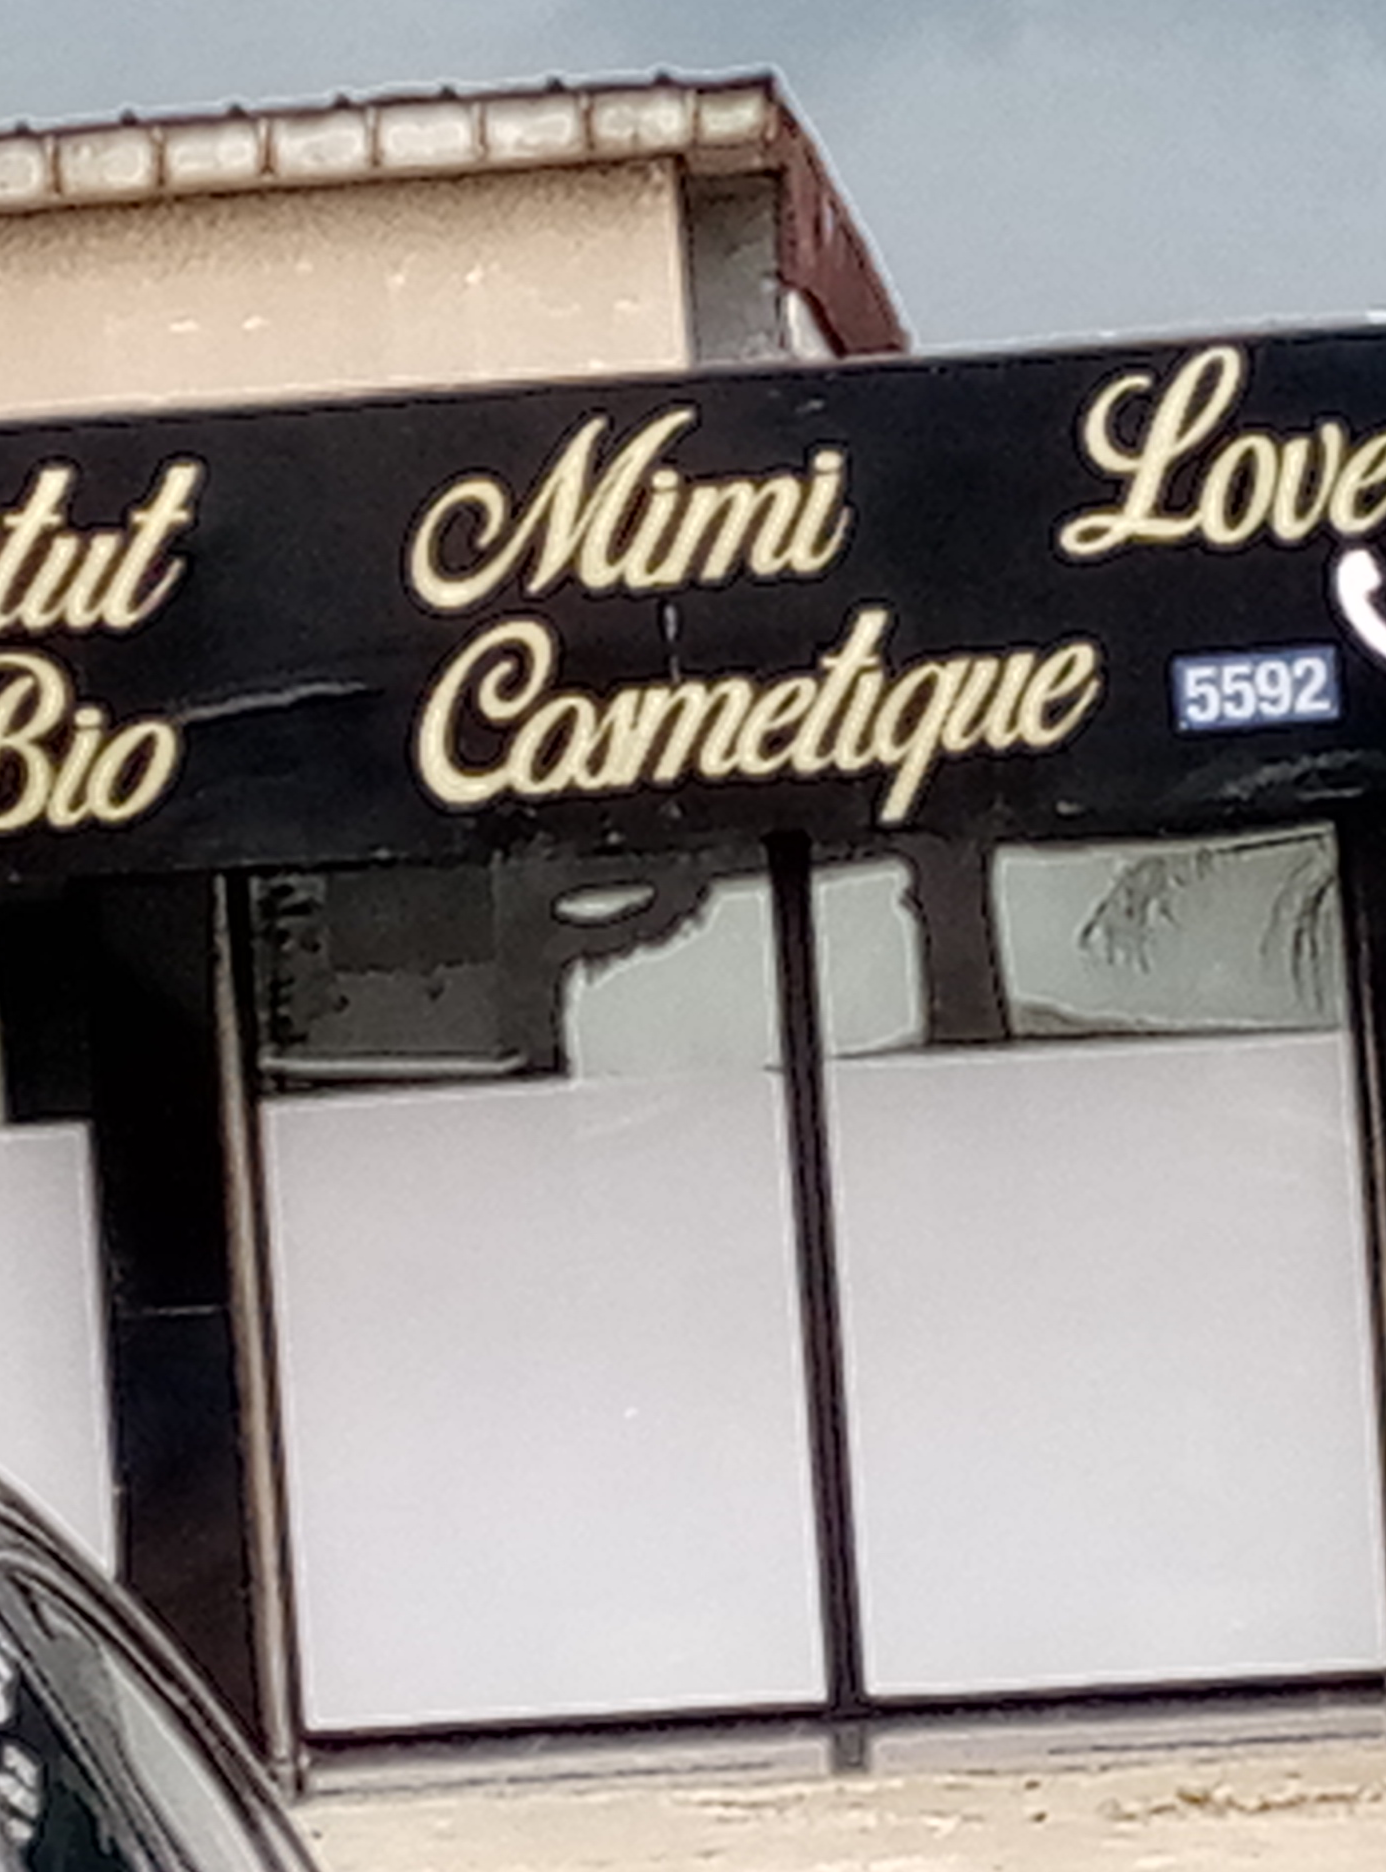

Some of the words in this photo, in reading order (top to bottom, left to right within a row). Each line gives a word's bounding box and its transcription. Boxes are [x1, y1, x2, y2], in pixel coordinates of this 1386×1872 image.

[410, 406, 855, 612] Mimi
[417, 606, 1103, 826] Cosmetique
[1183, 655, 1335, 723] 5592
